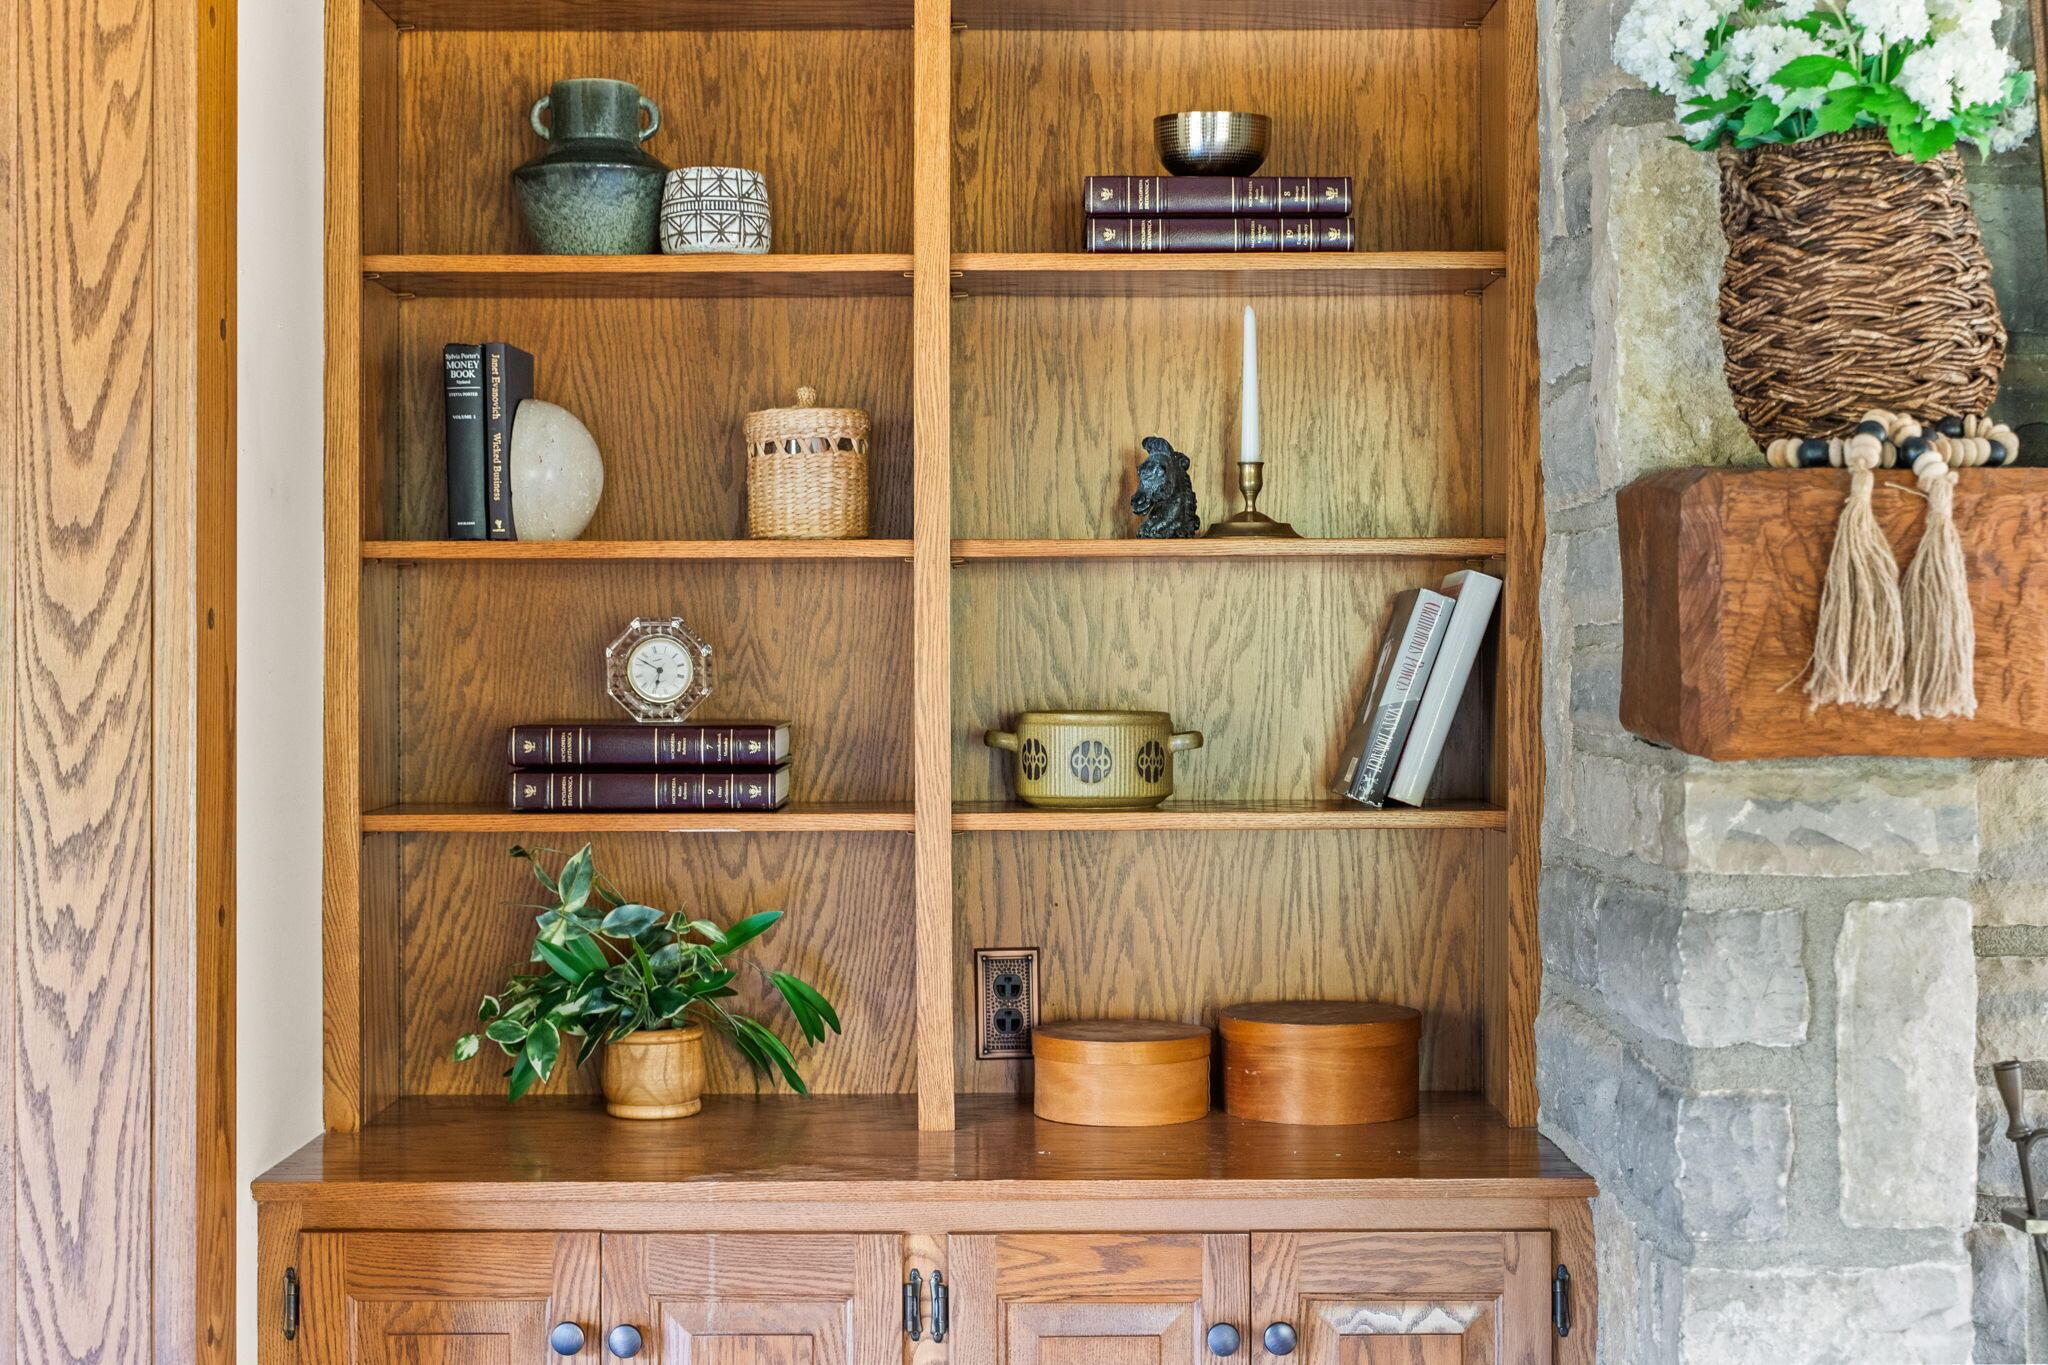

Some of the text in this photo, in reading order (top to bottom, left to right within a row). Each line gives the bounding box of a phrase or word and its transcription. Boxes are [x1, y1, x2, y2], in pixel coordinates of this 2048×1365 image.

[1285, 229, 1294, 239] 19
[445, 352, 480, 361] Sylvia Porter's
[446, 360, 480, 370] MONEY
[450, 370, 476, 379] BOOK
[491, 353, 501, 421] Janet Evanovich
[492, 432, 502, 502] Wicked Business
